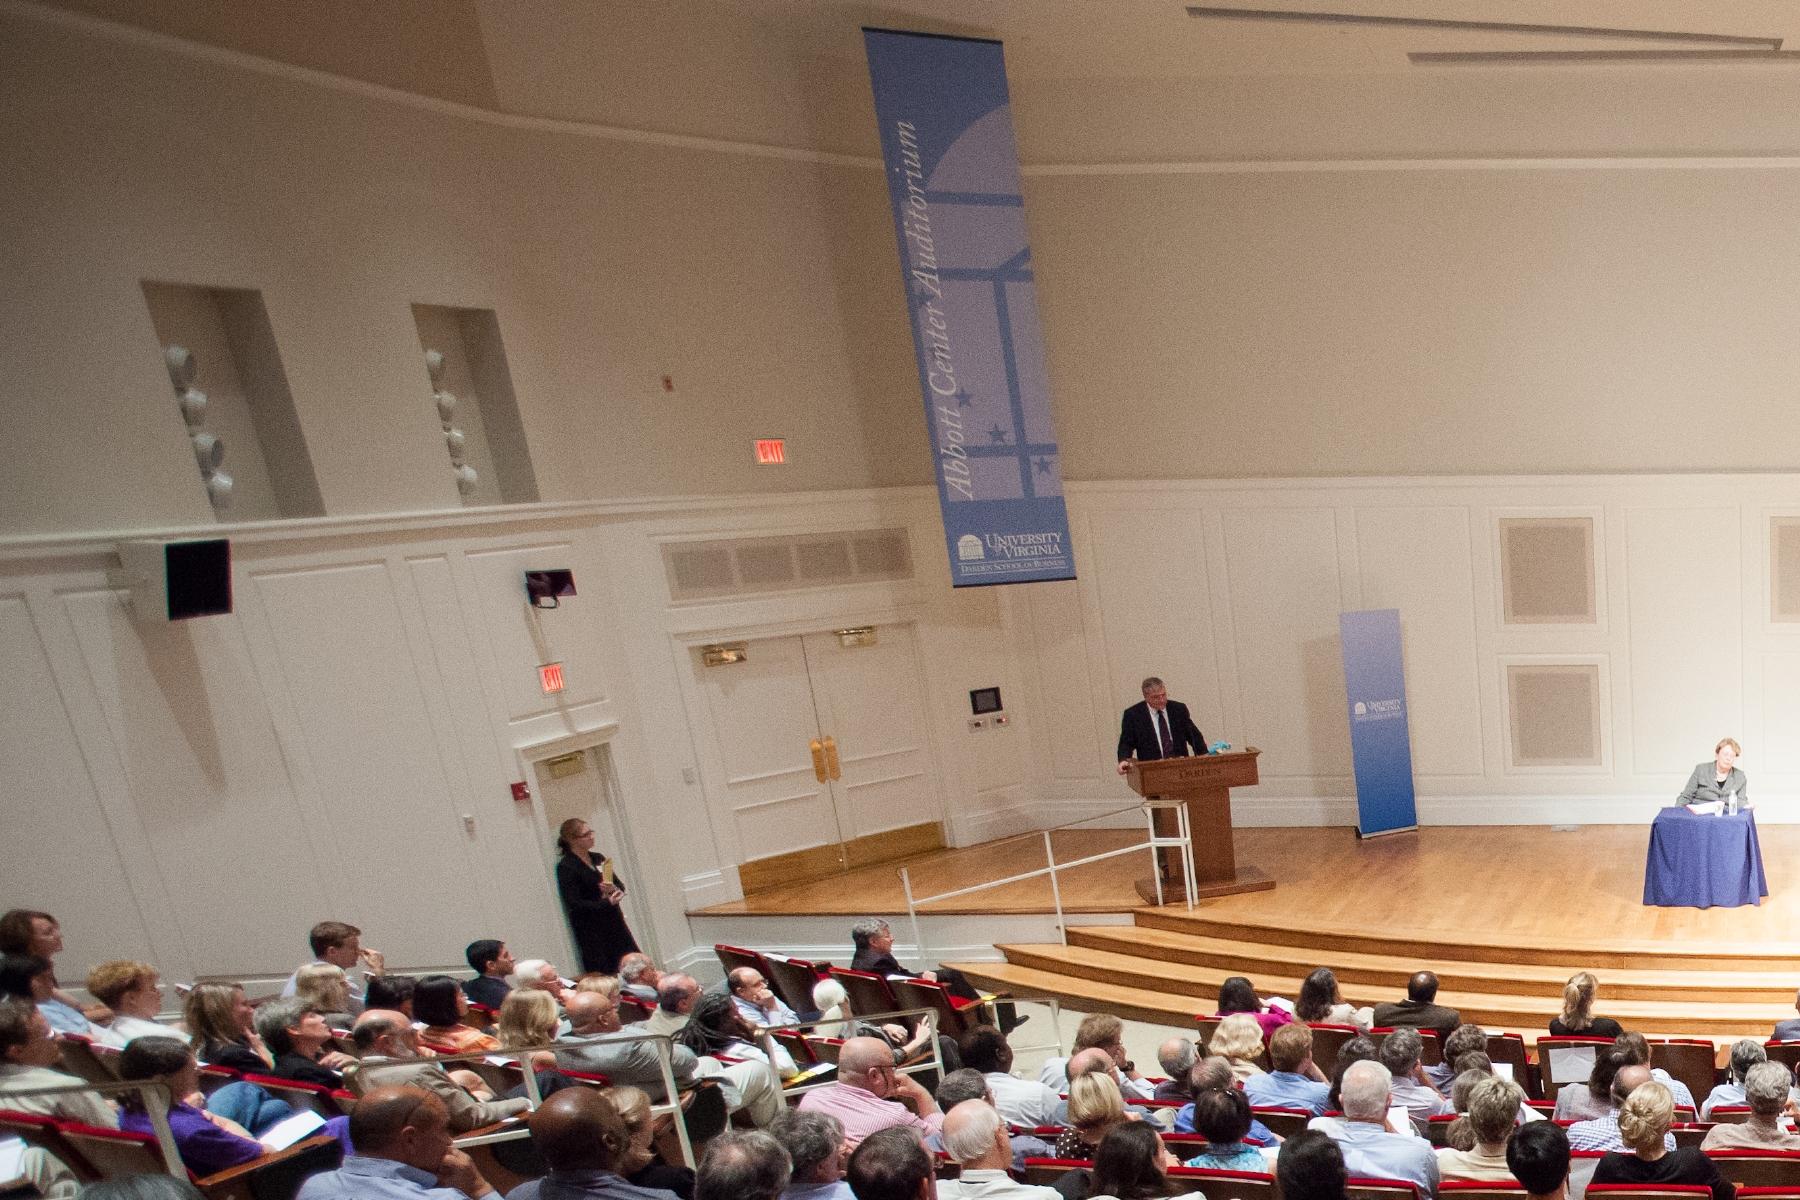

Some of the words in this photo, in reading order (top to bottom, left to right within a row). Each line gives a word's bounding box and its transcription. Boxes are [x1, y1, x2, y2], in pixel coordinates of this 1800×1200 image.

[895, 121, 942, 299] Auditorium
[927, 301, 957, 396] Center
[939, 405, 973, 500] Abbott
[985, 532, 1062, 549] UNIVERSITY
[1003, 544, 1061, 559] VIRGINIA
